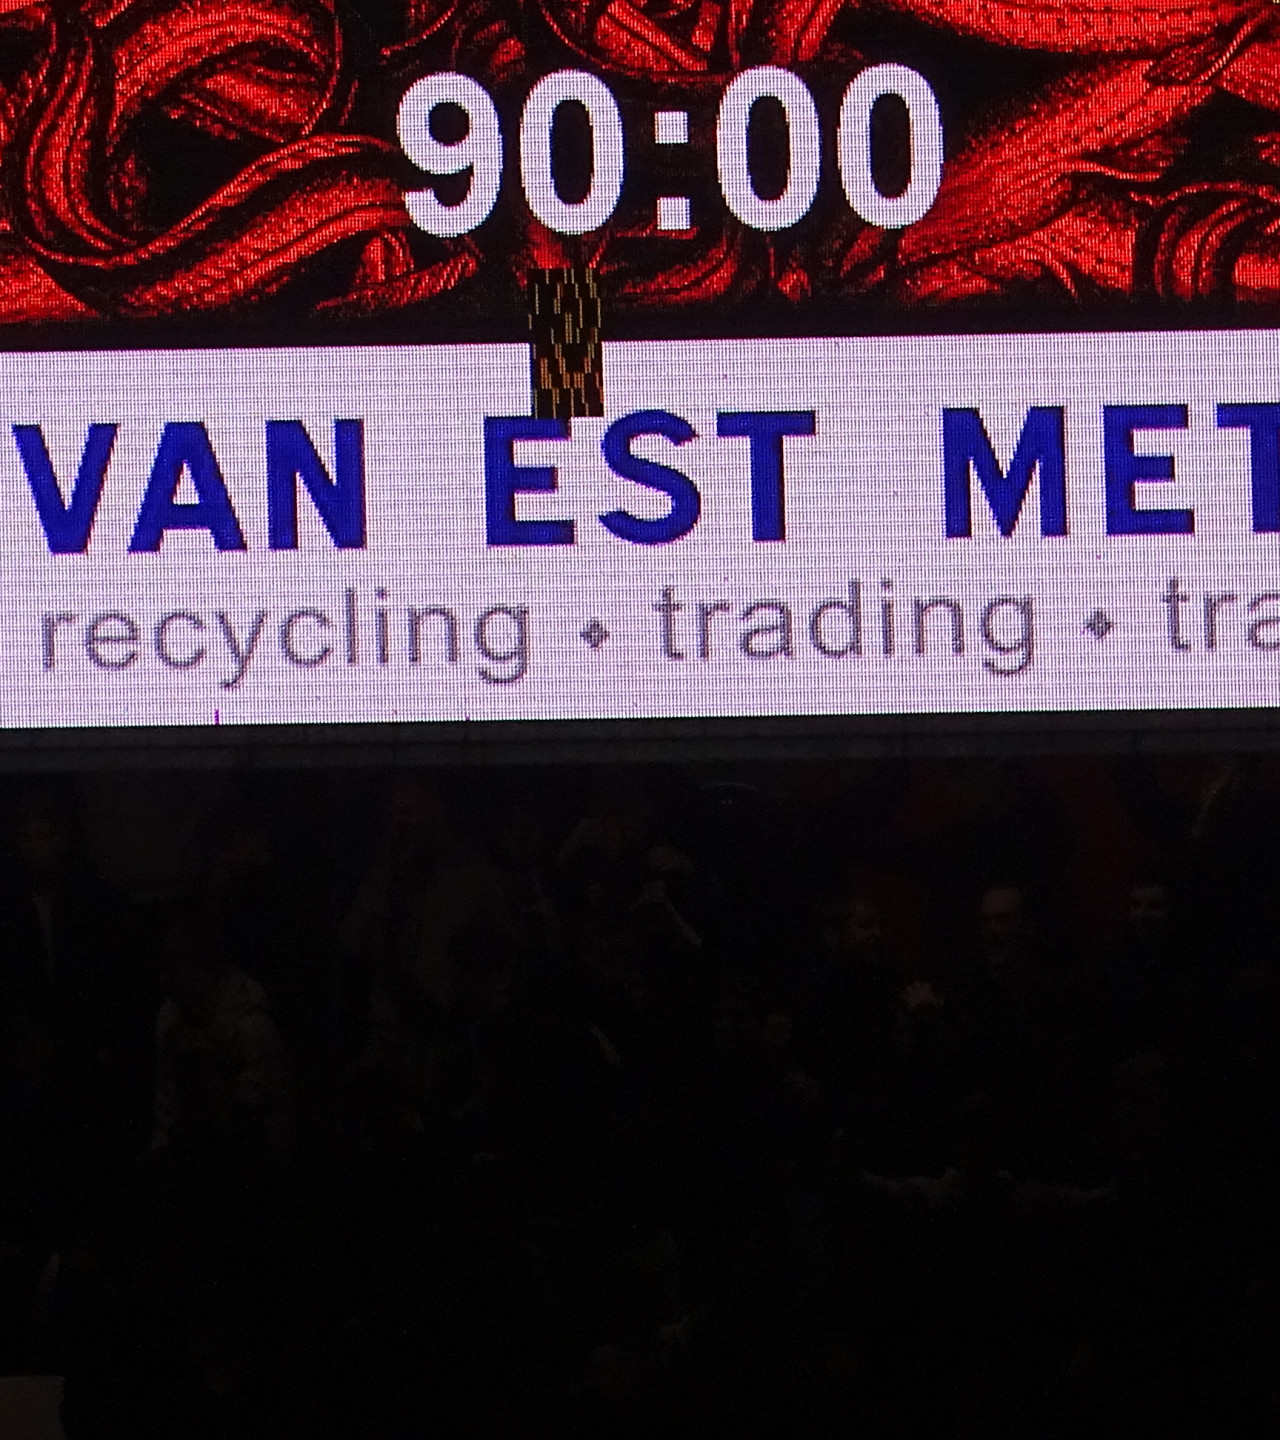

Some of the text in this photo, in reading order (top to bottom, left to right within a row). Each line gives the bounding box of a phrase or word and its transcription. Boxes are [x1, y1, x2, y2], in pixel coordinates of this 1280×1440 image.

[395, 63, 945, 237] 90:00
[12, 418, 367, 555] VAN
[484, 408, 817, 547] EST
[40, 587, 529, 688] recycling
[654, 578, 1036, 676] trading
